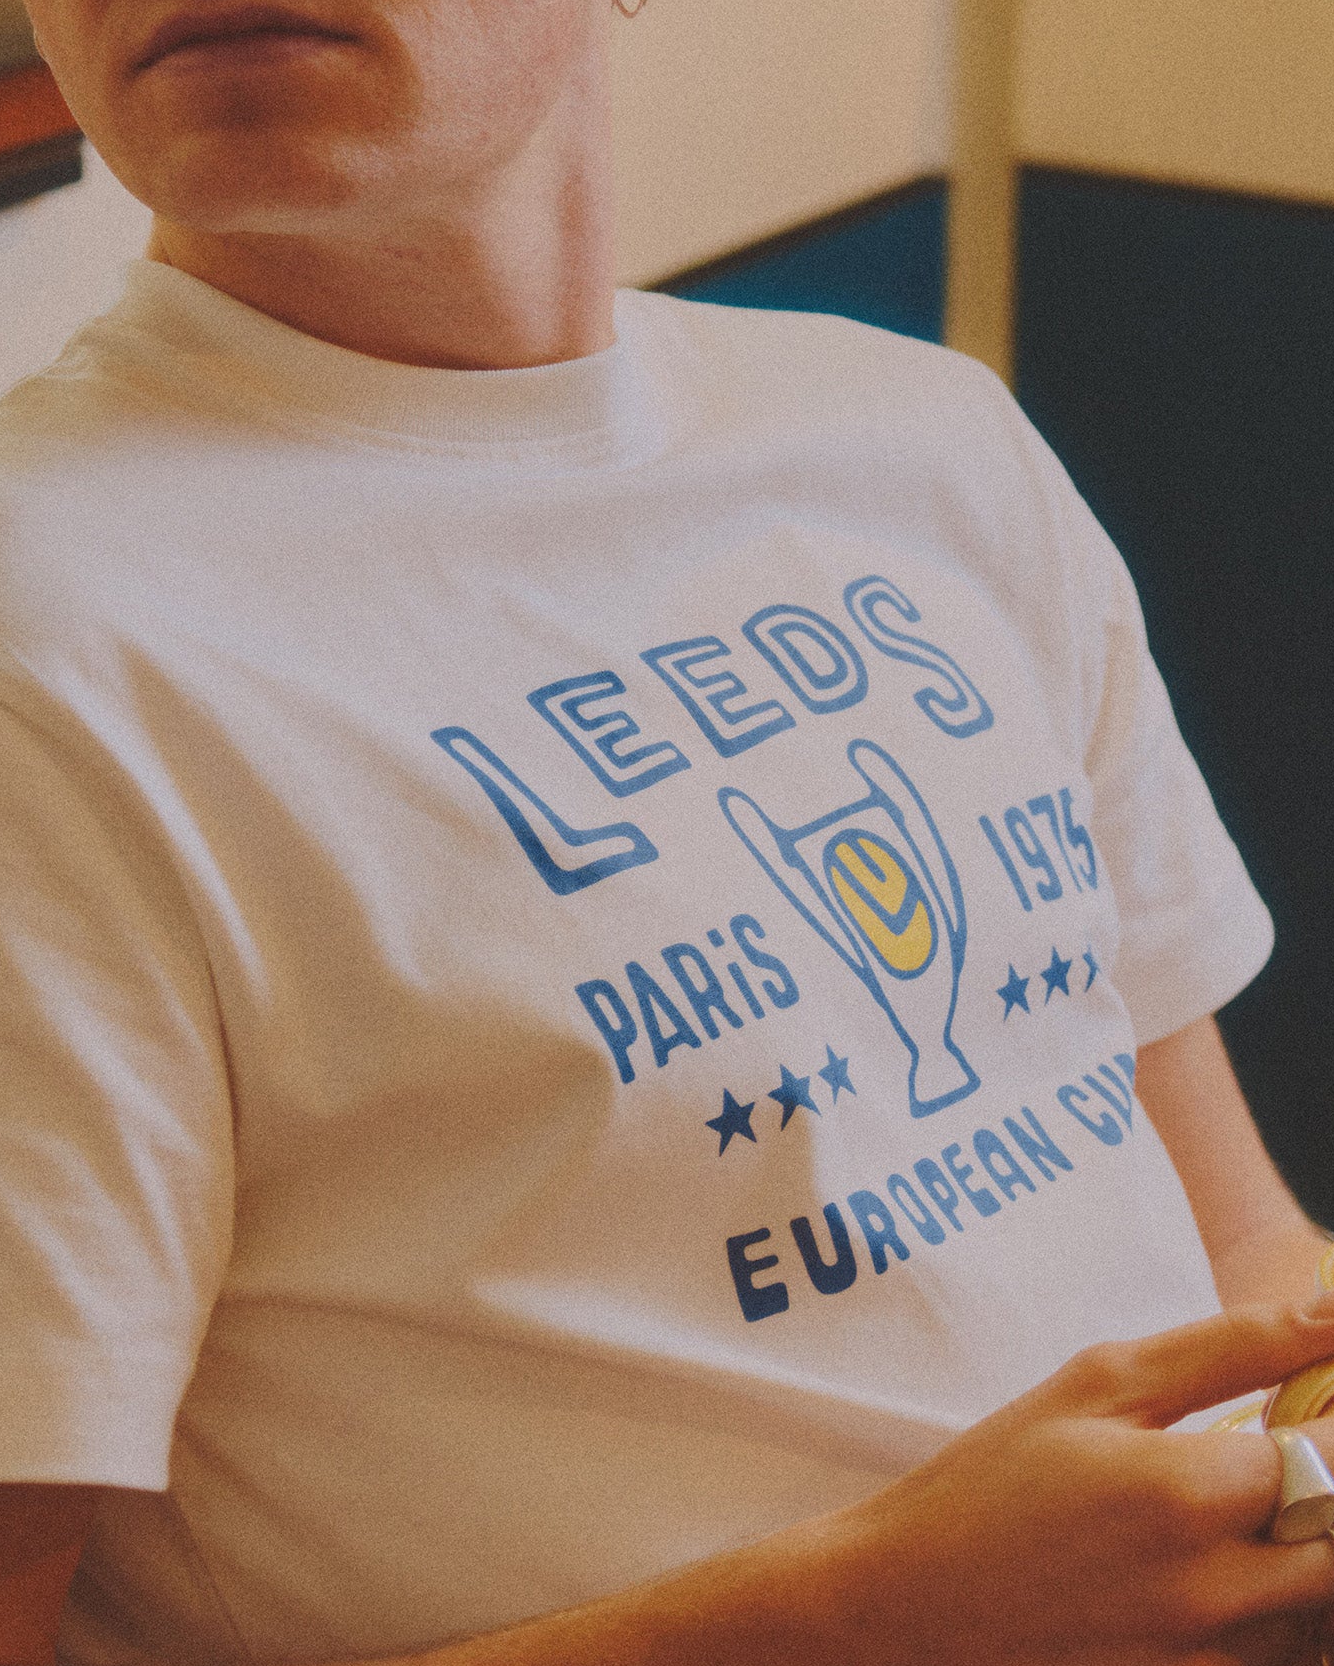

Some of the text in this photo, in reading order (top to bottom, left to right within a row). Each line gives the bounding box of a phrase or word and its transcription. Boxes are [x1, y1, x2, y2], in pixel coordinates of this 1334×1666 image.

[428, 573, 996, 898] LEEDS
[977, 785, 1100, 914] 1975
[726, 1105, 1075, 1321] EUROPEAN
